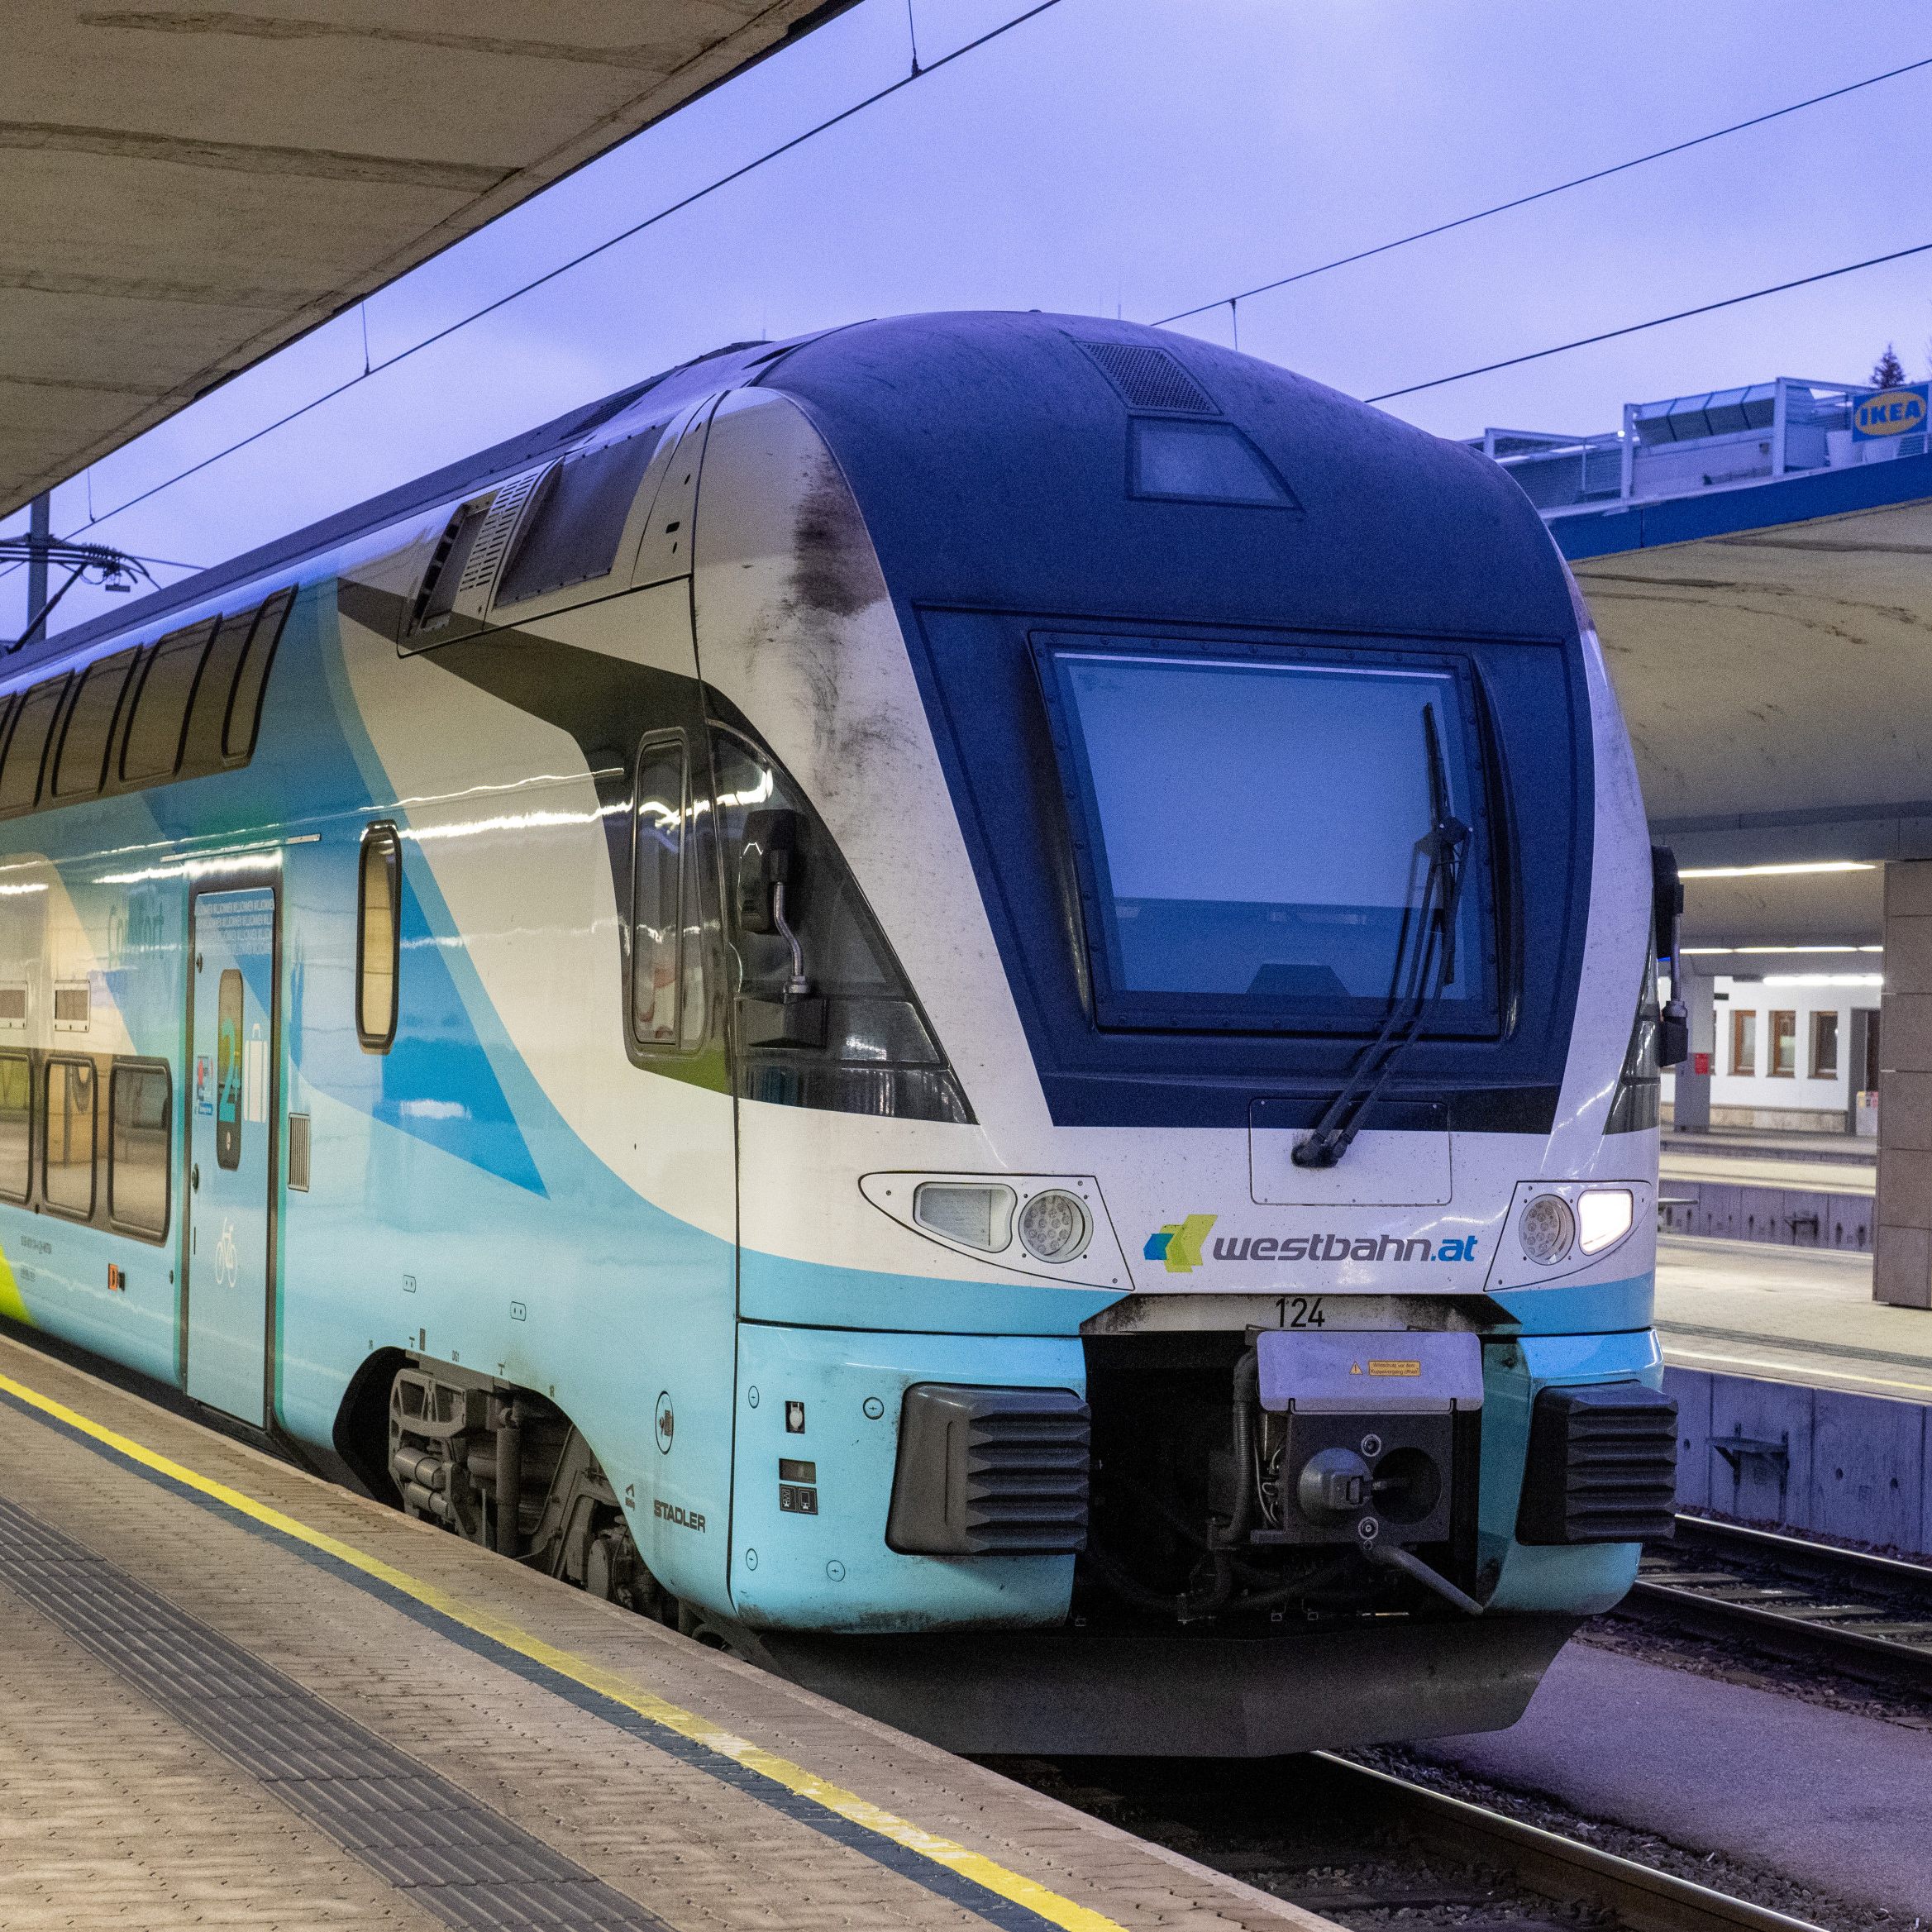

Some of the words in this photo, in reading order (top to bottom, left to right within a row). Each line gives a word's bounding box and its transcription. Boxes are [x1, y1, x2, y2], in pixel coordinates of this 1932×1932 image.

[1859, 400, 1921, 427] IKEA
[1213, 1233, 1477, 1262] westbahn.at
[1276, 1297, 1325, 1328] 124
[653, 1500, 706, 1534] STADLER
